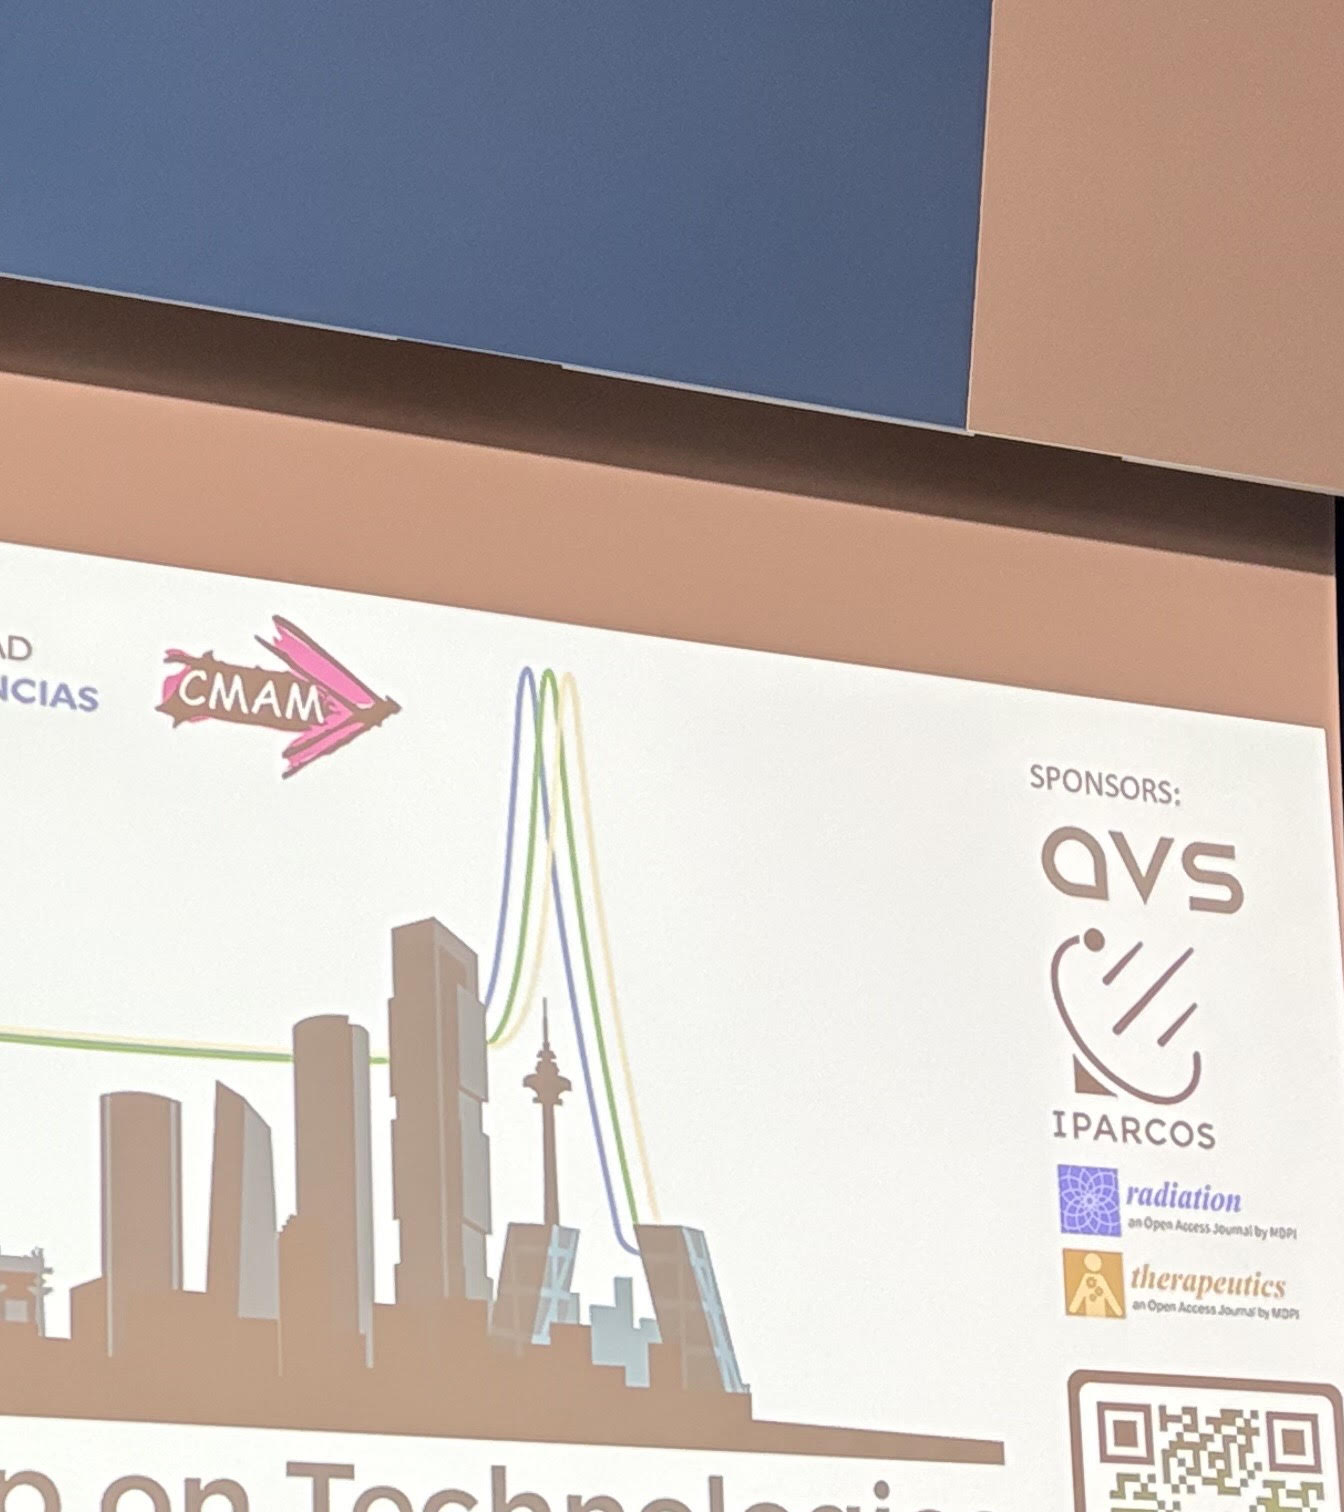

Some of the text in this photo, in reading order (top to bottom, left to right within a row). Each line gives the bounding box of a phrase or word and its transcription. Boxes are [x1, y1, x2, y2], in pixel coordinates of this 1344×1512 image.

[178, 668, 325, 724] CMAM
[1029, 762, 1182, 807] SPONSORS:
[1052, 1109, 1217, 1151] IPARCOS
[1126, 1180, 1243, 1213] radiation
[1127, 1215, 1298, 1241] an Open Access Journal by MDPI
[1130, 1263, 1287, 1300] therapeutics
[1132, 1299, 1300, 1320] an Open Access Journal by MDPI
